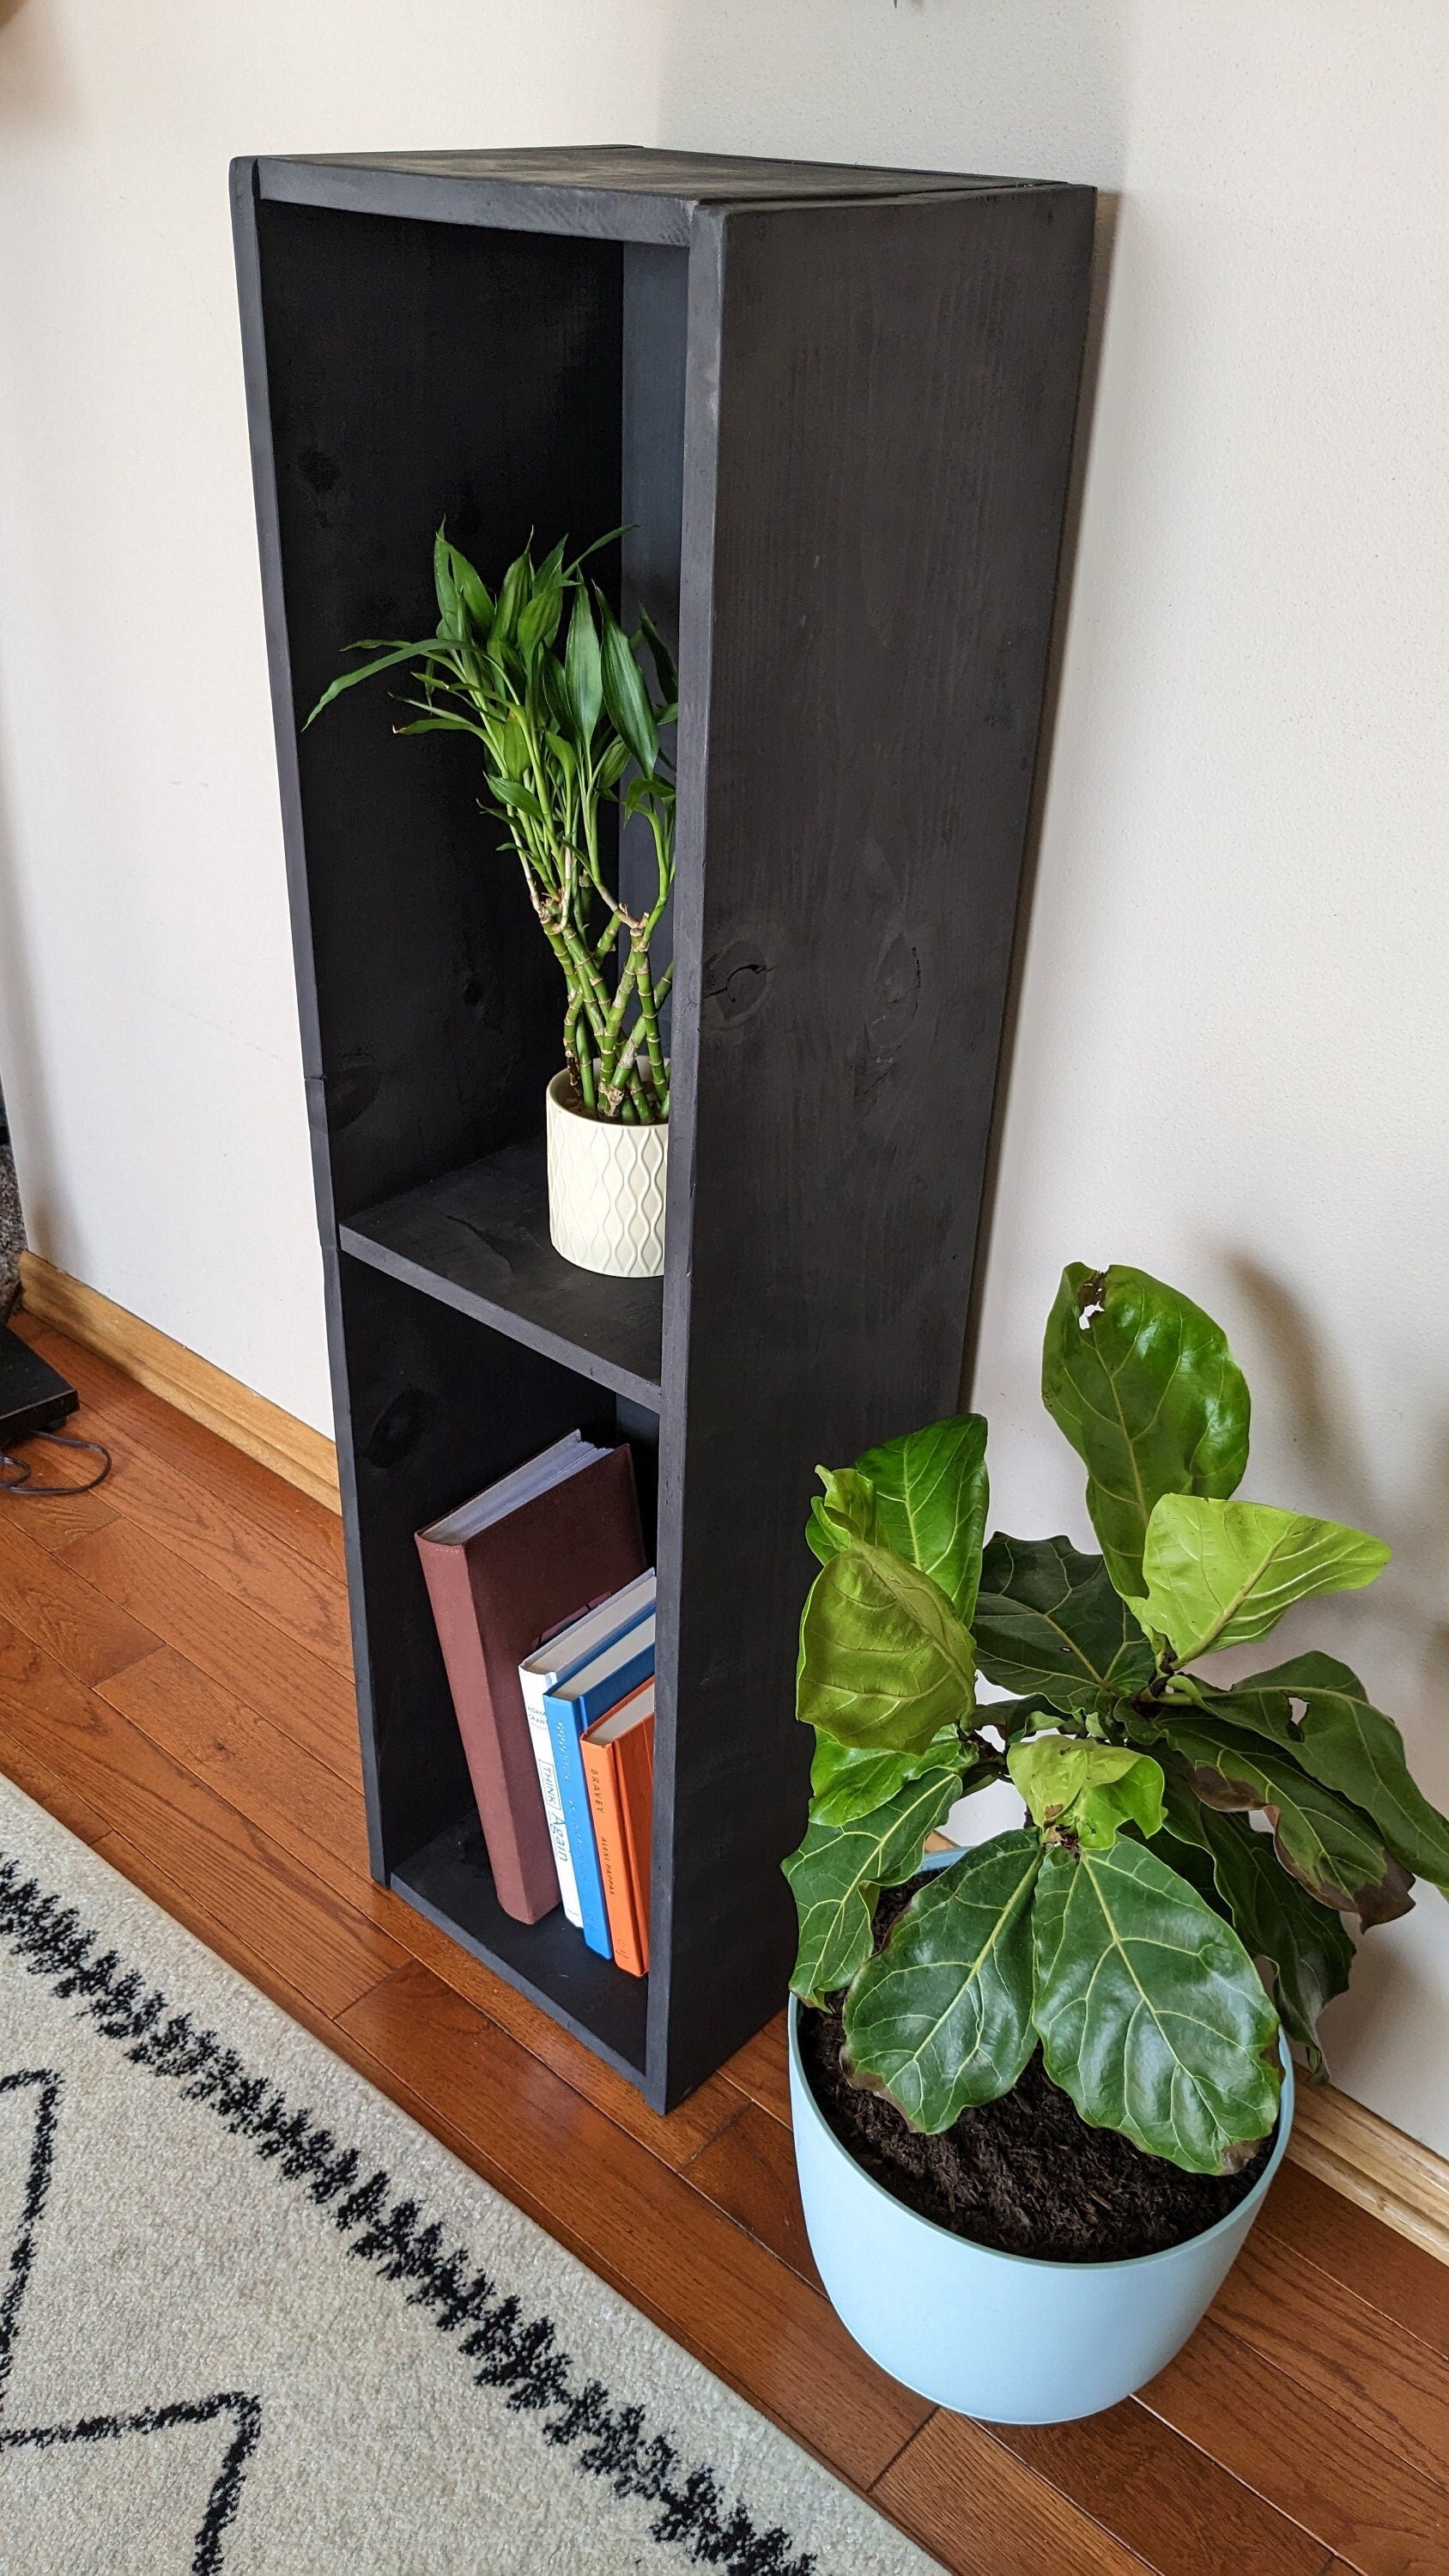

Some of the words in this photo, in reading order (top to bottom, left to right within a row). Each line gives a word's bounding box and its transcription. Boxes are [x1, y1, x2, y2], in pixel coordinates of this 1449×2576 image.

[543, 1767, 556, 1804] THINK
[550, 1812, 567, 1862] Again
[591, 1768, 604, 1814] BRAVEY
